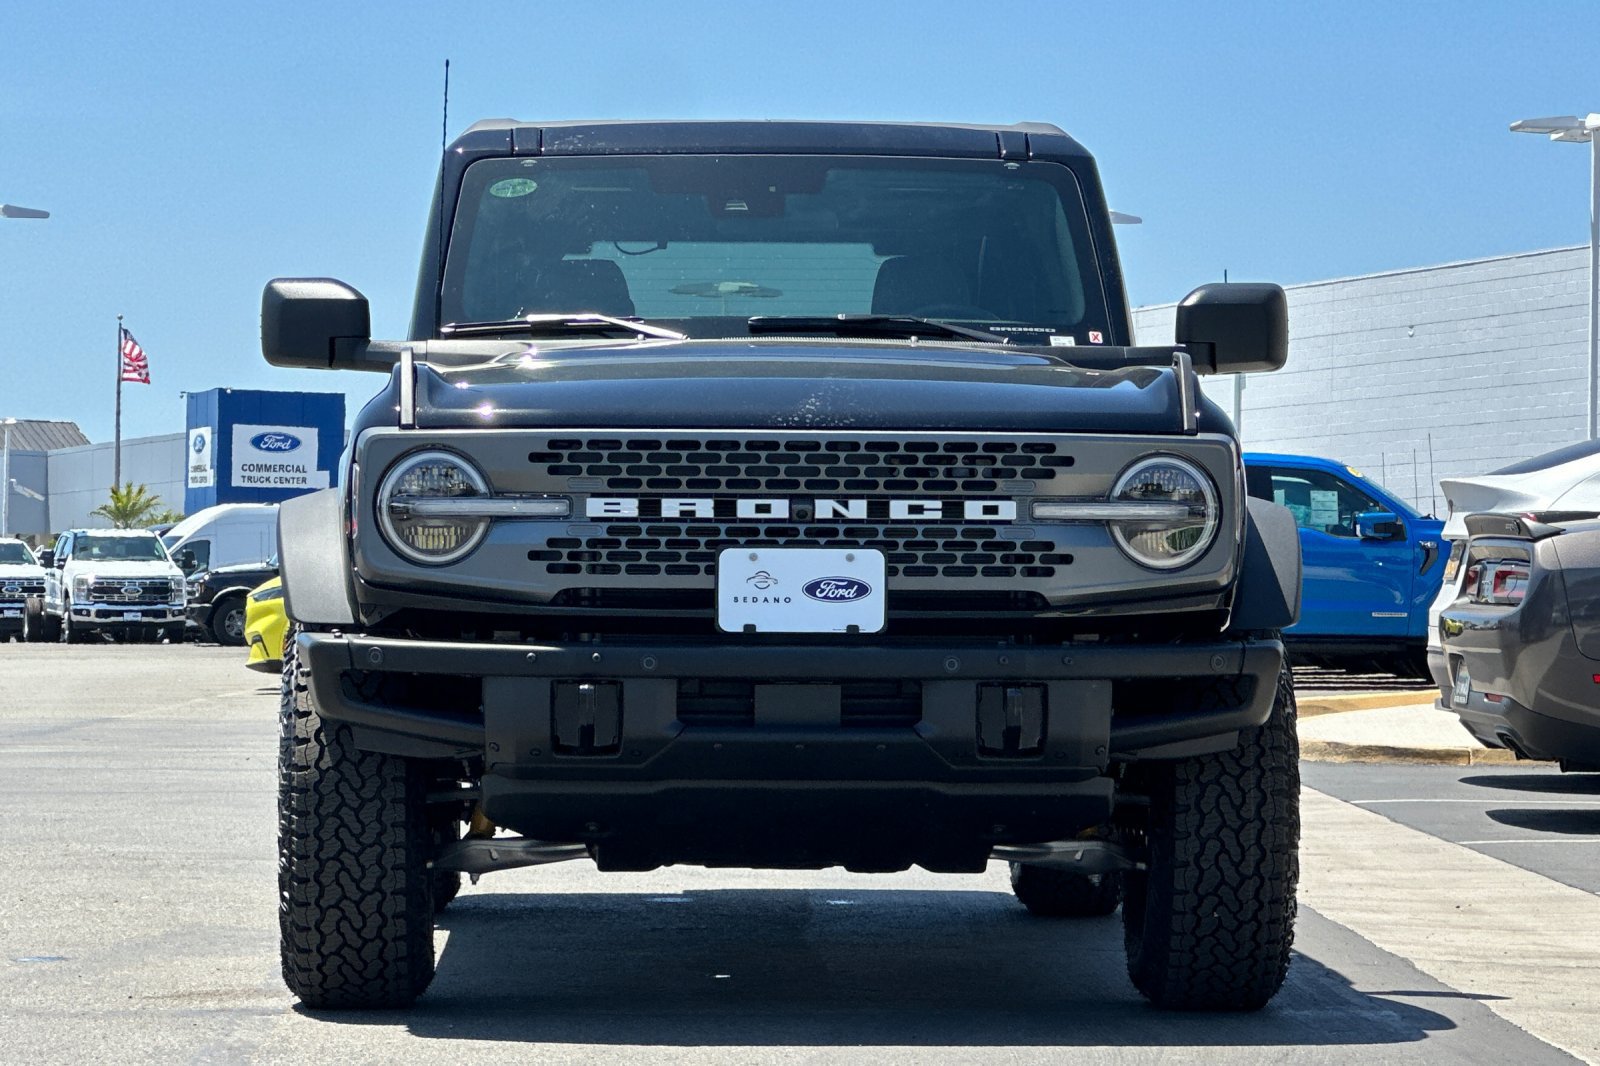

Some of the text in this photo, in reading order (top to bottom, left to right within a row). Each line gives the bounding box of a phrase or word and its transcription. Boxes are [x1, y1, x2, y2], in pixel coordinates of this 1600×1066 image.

[260, 434, 292, 450] Ford
[241, 463, 308, 474] COMMERCIAL
[240, 475, 307, 485] TRUCK CENTER
[586, 497, 1017, 520] BRONCO
[815, 579, 858, 599] Ford
[733, 596, 792, 604] SEDANO
